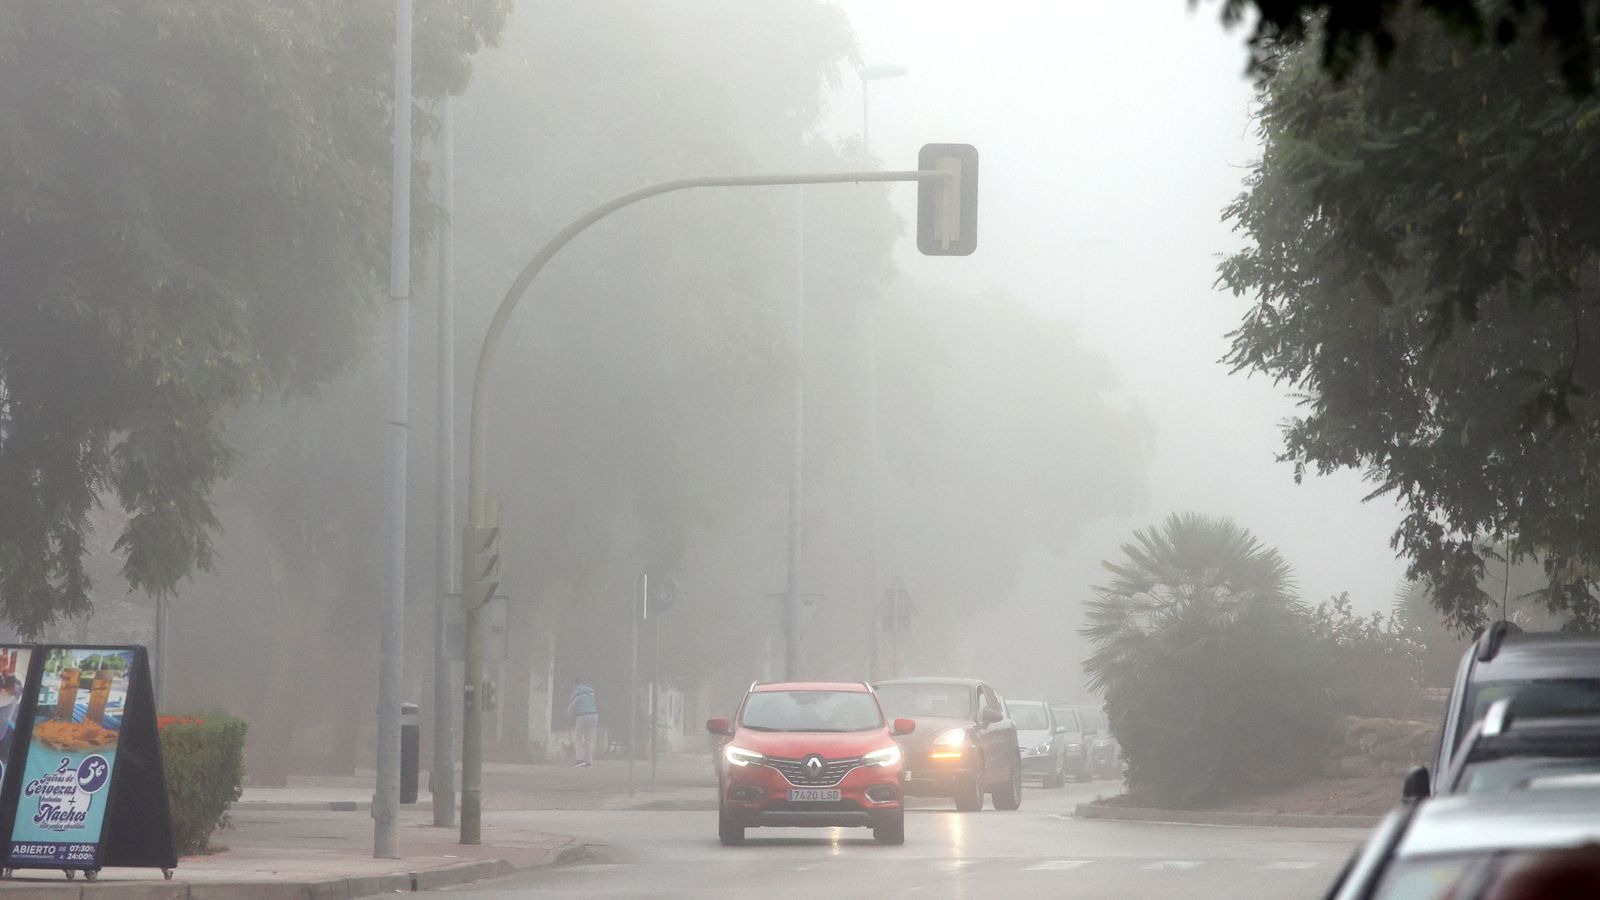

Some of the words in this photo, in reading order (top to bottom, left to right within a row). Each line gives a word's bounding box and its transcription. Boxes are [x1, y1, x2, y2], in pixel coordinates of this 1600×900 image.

[57, 757, 70, 773] 2
[65, 774, 74, 782] de
[25, 780, 77, 796] Cervezas
[794, 791, 818, 800] 7420
[820, 791, 839, 800] LSD
[33, 803, 87, 822] Nachos
[12, 845, 56, 855] ABIERTO
